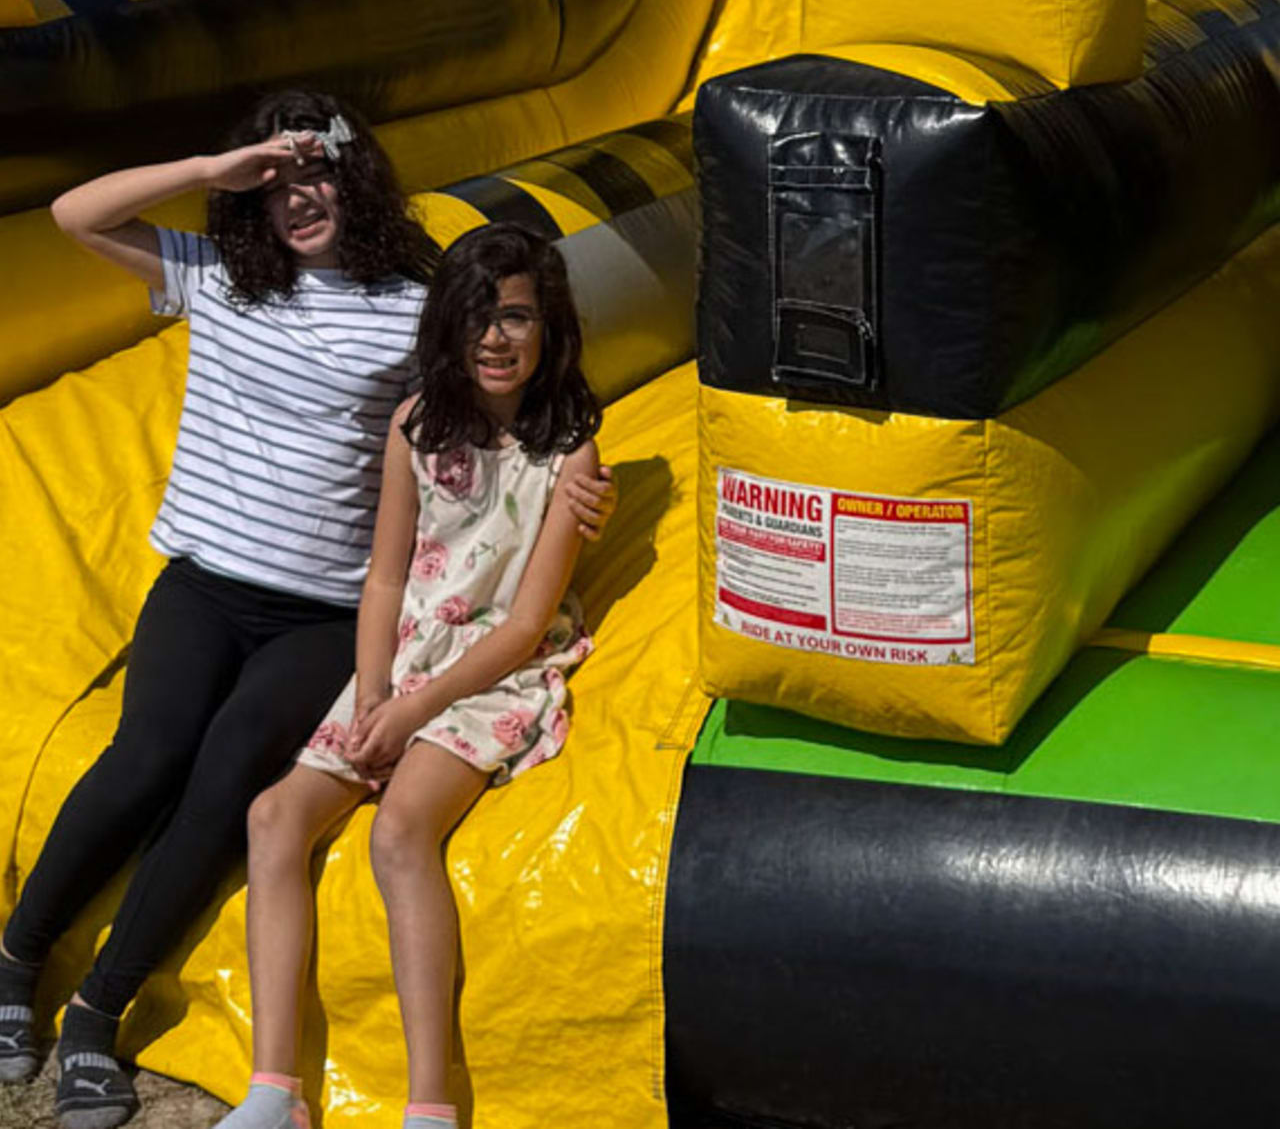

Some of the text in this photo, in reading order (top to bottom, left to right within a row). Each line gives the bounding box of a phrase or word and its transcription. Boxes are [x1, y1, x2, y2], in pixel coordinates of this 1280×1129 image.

[722, 474, 823, 523] WARNING
[837, 497, 884, 516] OWNER
[895, 503, 965, 519] OPERATOR
[722, 502, 754, 524] PARENTS
[764, 516, 824, 538] GUARDIANS
[741, 620, 928, 663] RIDE AT YOUR OWN RISK
